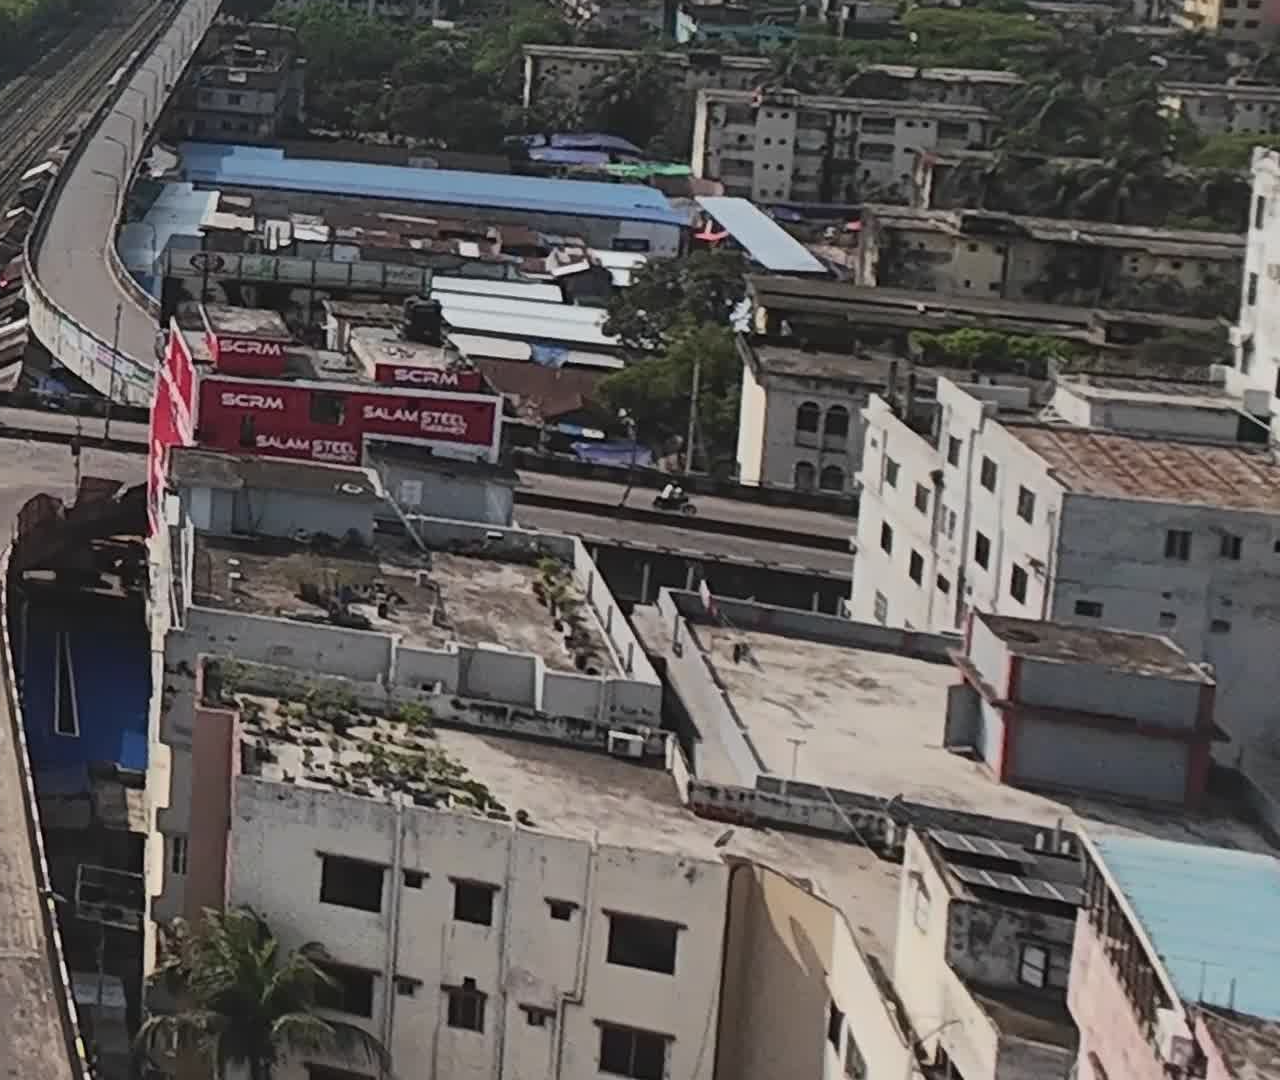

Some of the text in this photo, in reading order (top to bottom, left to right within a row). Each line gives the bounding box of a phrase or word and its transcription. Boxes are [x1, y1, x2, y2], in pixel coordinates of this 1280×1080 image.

[220, 339, 281, 355] SCRM
[394, 369, 458, 385] SCRM
[221, 393, 284, 409] SCRM
[363, 406, 465, 428] SALAM STEEL
[256, 435, 356, 457] SALAM STEEL
